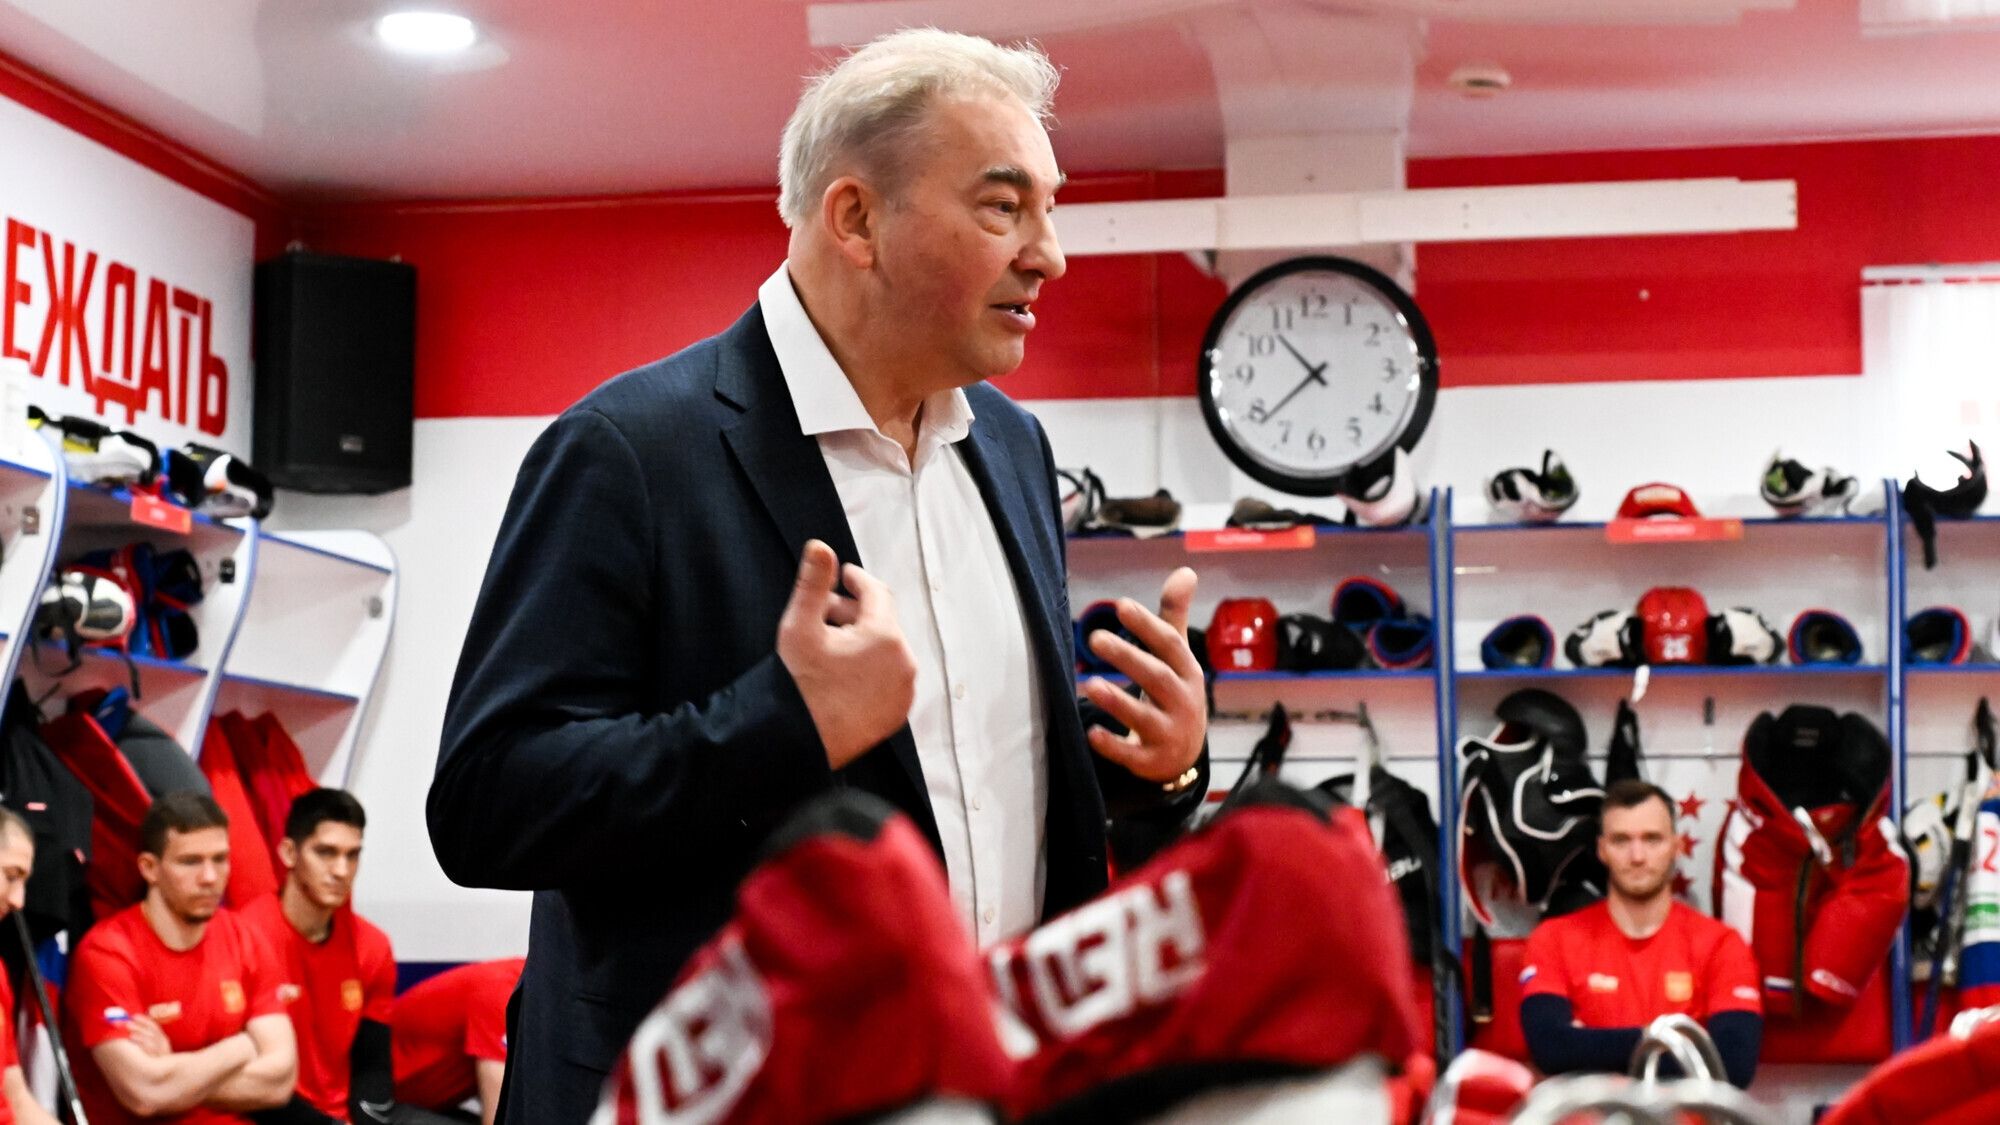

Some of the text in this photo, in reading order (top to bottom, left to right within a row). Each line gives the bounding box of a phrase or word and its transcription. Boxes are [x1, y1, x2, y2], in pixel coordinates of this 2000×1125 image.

[1271, 306, 1293, 330] 11
[1301, 295, 1328, 318] 12
[3, 216, 228, 437] ЕЖДАТЬ
[1365, 322, 1381, 347] 2
[1249, 333, 1275, 357] 10
[1236, 364, 1254, 385] 9
[1382, 357, 1397, 382] 3
[1249, 399, 1267, 424] 8
[1368, 391, 1384, 414] 4
[1278, 421, 1292, 444] 7
[1307, 428, 1325, 451] 6
[1349, 417, 1362, 446] 5
